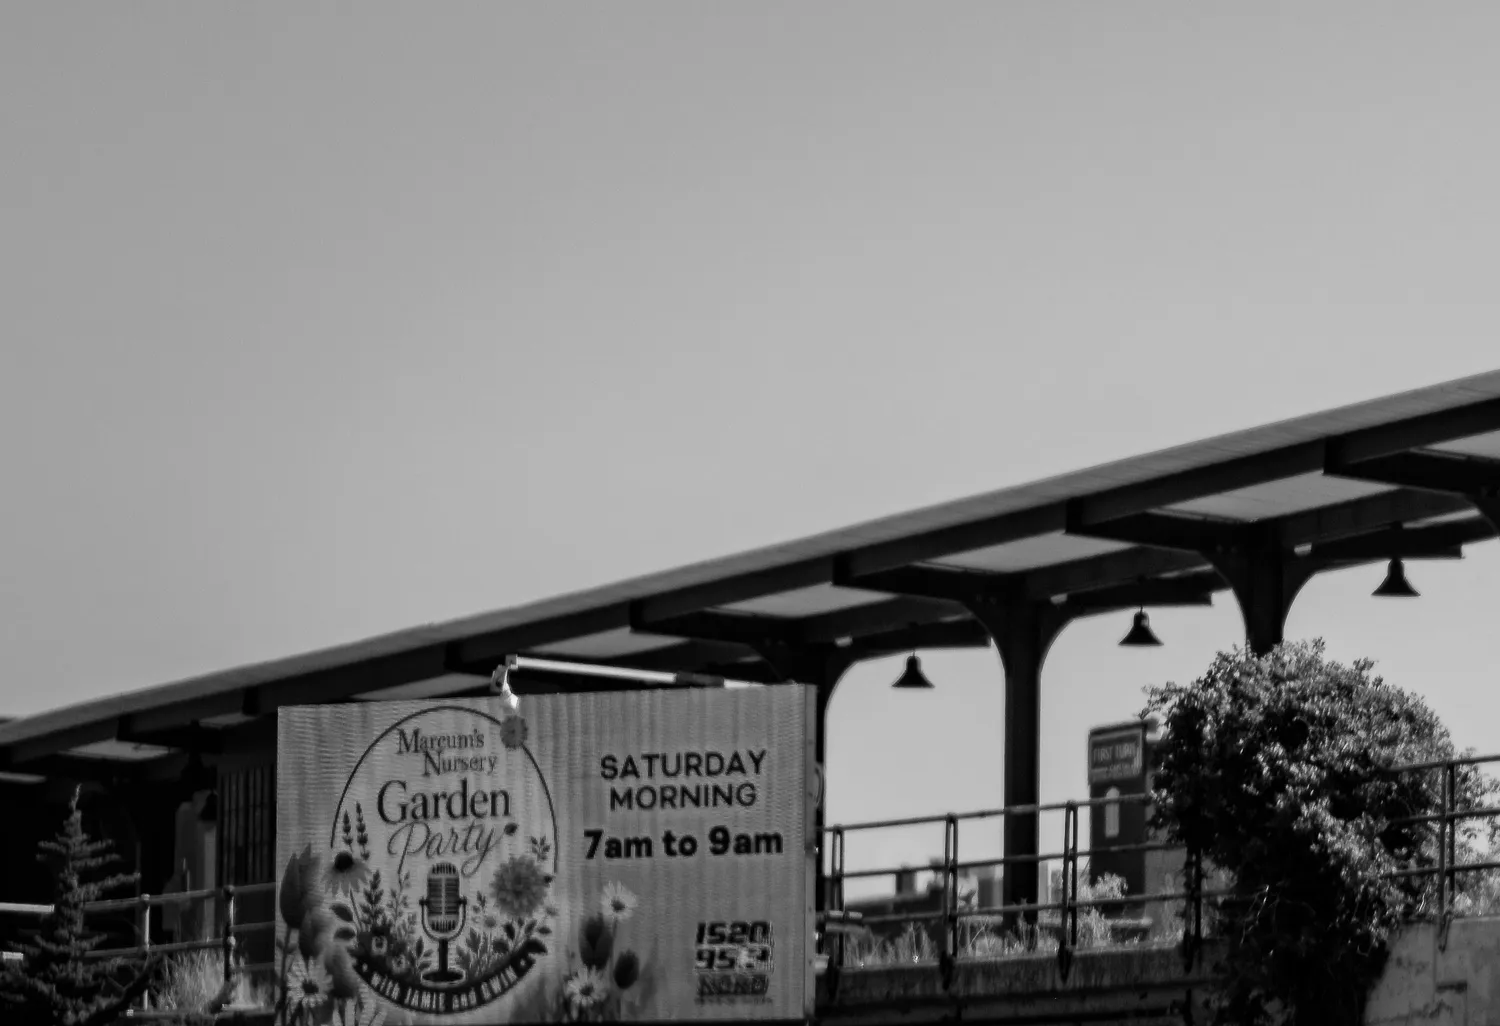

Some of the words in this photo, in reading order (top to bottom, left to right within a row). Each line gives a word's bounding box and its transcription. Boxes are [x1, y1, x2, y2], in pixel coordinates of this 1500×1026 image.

[396, 728, 485, 754] Marcum's
[422, 750, 498, 777] Nursery
[600, 749, 766, 780] SATURDAY
[376, 777, 511, 824] Garden
[610, 782, 757, 811] MORNING
[387, 818, 503, 878] Party
[584, 828, 654, 860] 7am
[661, 829, 698, 857] to
[708, 825, 784, 856] 9am
[404, 986, 446, 1012] JAMIE
